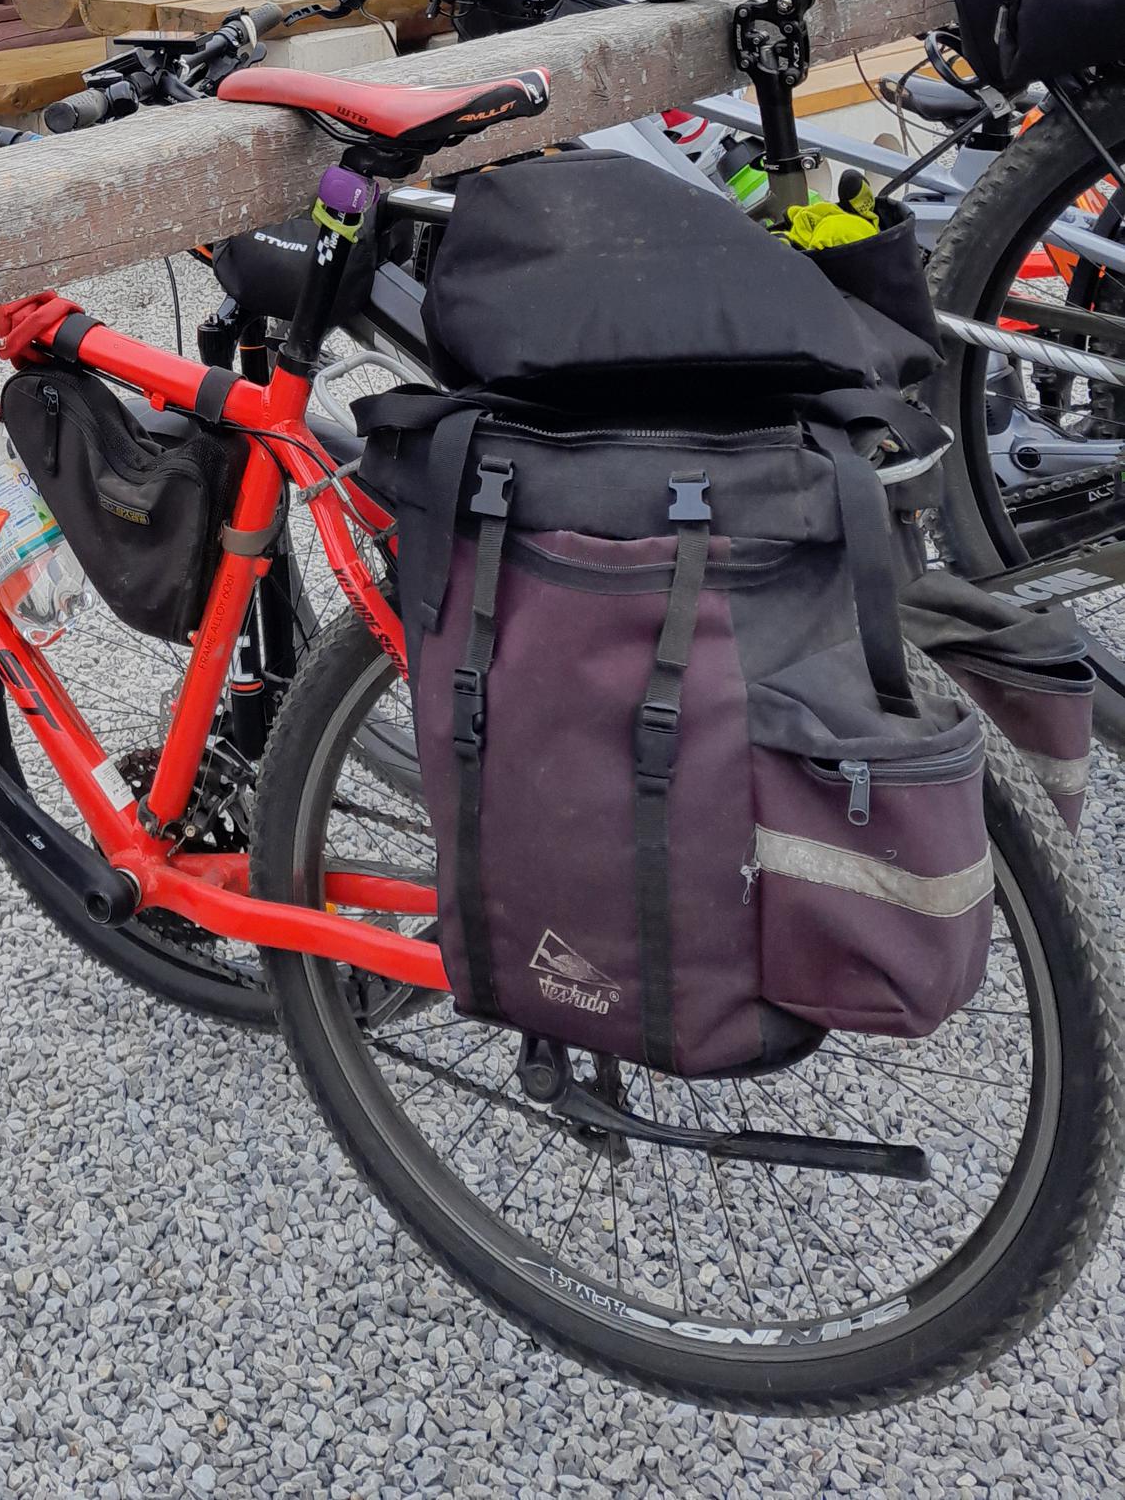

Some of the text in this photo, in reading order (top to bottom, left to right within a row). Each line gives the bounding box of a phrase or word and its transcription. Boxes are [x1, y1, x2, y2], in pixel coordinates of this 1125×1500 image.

[337, 105, 369, 125] WTB
[457, 100, 516, 122] AMULET
[253, 231, 309, 253] BTWIN
[198, 636, 216, 669] FRAME
[210, 600, 227, 635] ALLOY
